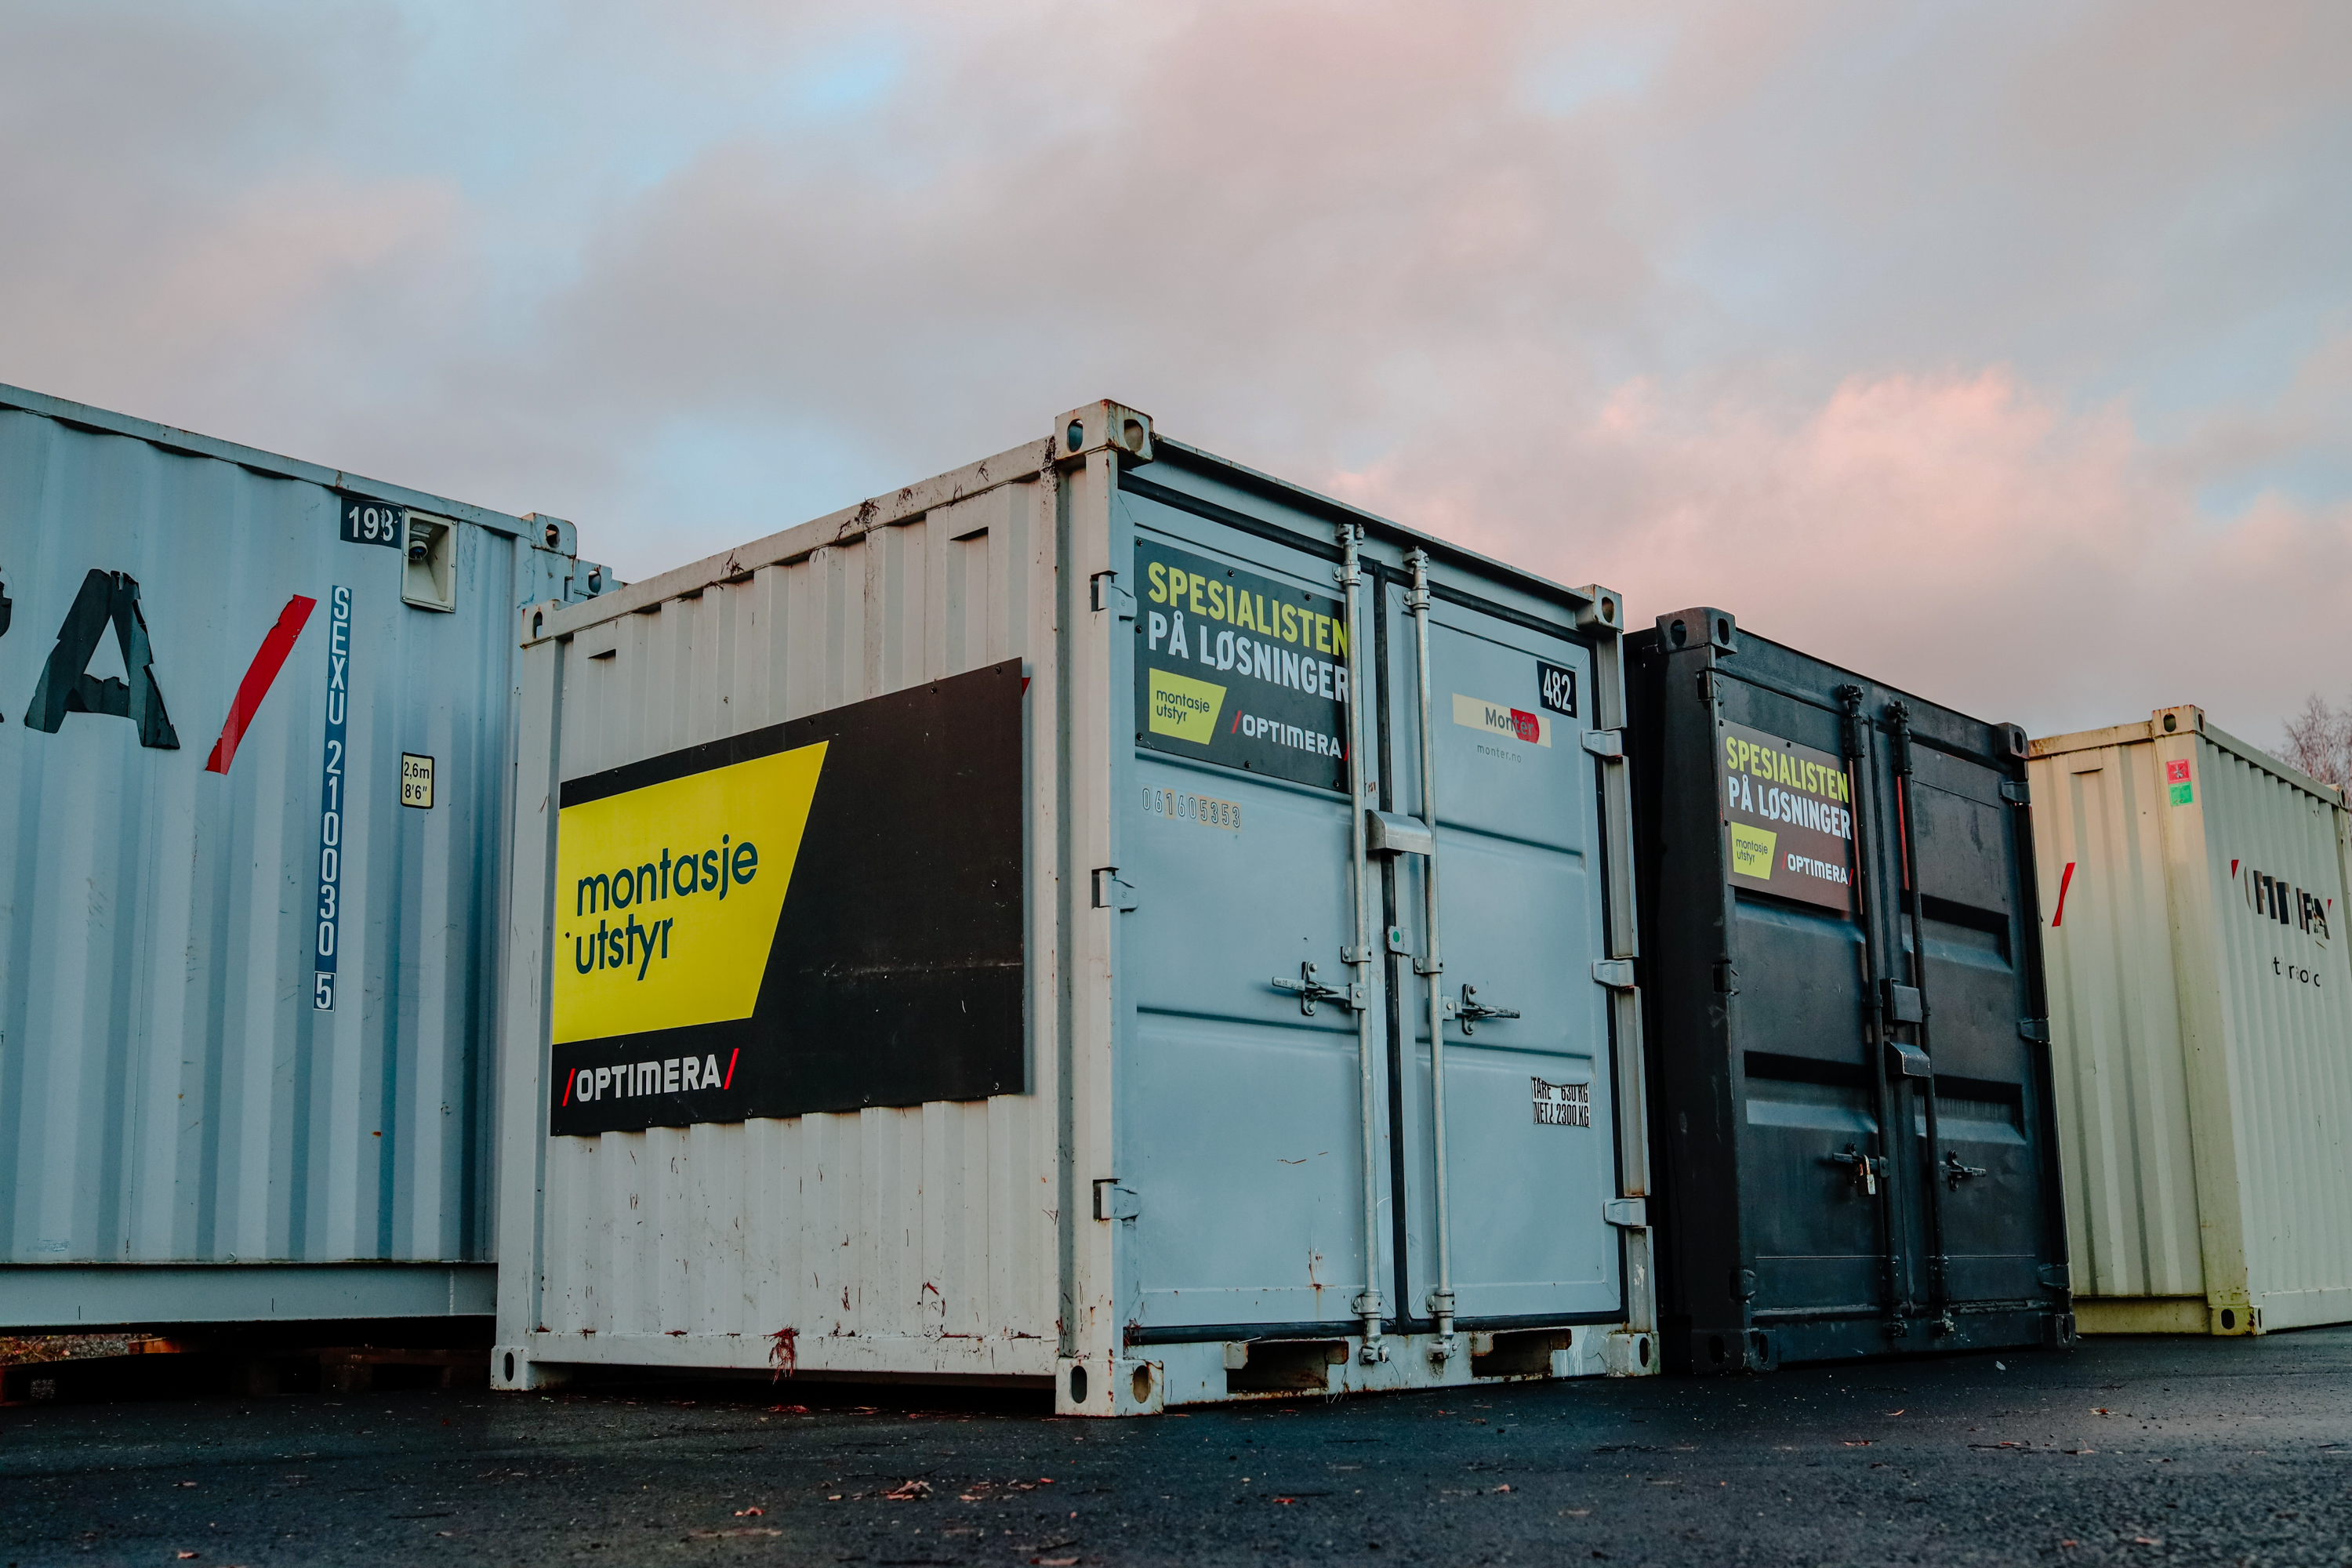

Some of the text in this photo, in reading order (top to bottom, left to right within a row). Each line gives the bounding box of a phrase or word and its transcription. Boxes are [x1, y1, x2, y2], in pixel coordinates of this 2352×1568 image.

[1148, 561, 1348, 659] SPESIALISTEN
[1148, 610, 1349, 704] PÅ LØSNINGER
[1156, 688, 1210, 714] montasje
[1543, 668, 1572, 712] 482
[1156, 704, 1188, 724] utstyr
[1485, 706, 1534, 736] Montér
[404, 761, 430, 779] 2,6m
[1477, 745, 1522, 763] monter.no
[1726, 736, 1849, 804] SPESIALISTEN
[317, 586, 351, 1010] SEXU 210030 5
[1142, 788, 1240, 828] 061605353
[1728, 774, 1852, 840] PÅ LØSNINGER
[1736, 837, 1769, 855] montasje
[1737, 850, 1755, 866] utstyr
[576, 834, 758, 916] montasje
[575, 913, 674, 982] utstyr
[1578, 1083, 1589, 1103] KG
[1556, 1103, 1577, 1124] 2300
[1579, 1105, 1589, 1127] KG
